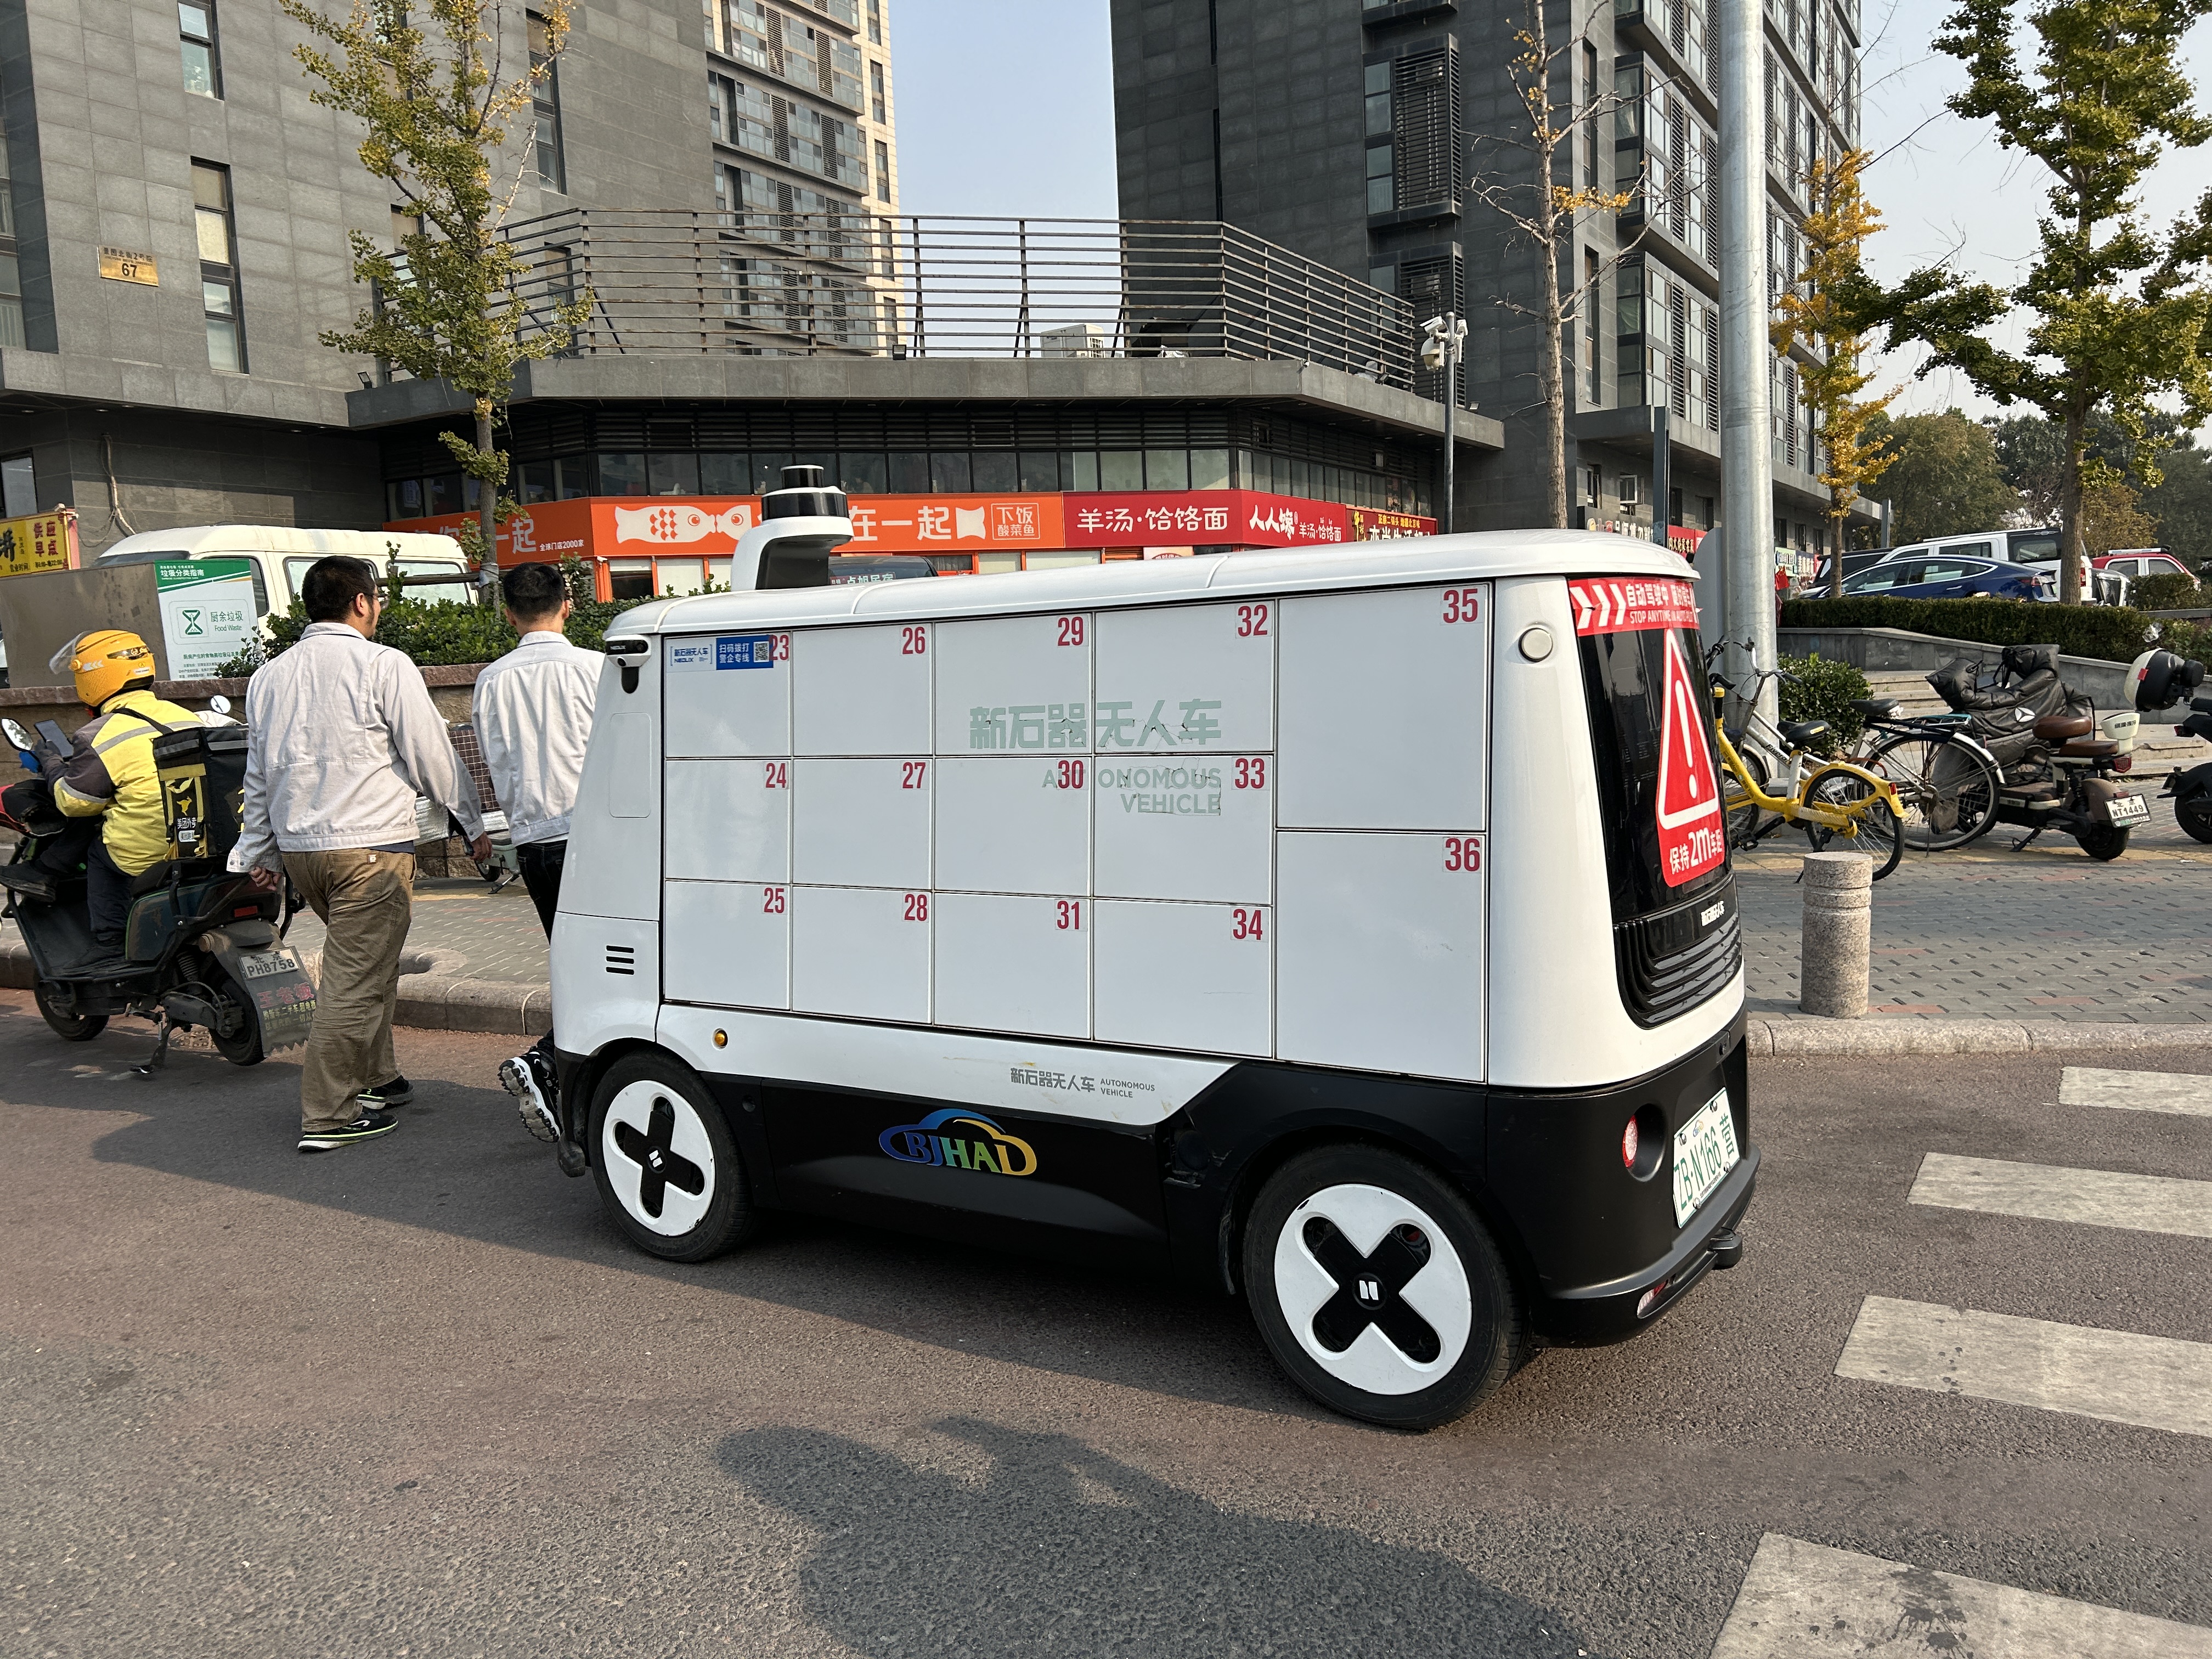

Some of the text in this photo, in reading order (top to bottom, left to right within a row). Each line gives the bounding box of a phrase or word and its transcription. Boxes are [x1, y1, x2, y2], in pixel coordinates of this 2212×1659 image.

[122, 263, 137, 277] 67
[996, 506, 1032, 524] 下饭
[997, 524, 1035, 537] 酸菜鱼
[35, 539, 59, 557] 早点
[539, 538, 584, 551] 全球门店2000家
[1444, 589, 1477, 623] 35
[1625, 583, 1669, 607] 自动驾驶中
[211, 611, 243, 622] 厨余垃圾
[1238, 605, 1267, 636] 32
[1630, 610, 1646, 624] STOP
[1648, 610, 1671, 623] ANYTIME
[902, 627, 925, 654] 26
[1058, 617, 1084, 646] 29
[719, 643, 750, 653] 扫码拨打
[769, 635, 789, 661] 23
[970, 699, 1221, 749] 新石器无人车
[766, 763, 786, 788] 24
[902, 762, 926, 788] 27
[1058, 760, 1084, 789] 30
[1235, 758, 1265, 788] 33
[1121, 793, 1221, 814] VEHICLE
[2112, 805, 2144, 817] NT1449
[177, 817, 197, 829] 美团外卖
[1446, 838, 1480, 871] 36
[1669, 827, 1723, 874] 保持2m车距
[764, 888, 785, 913] 25
[905, 894, 927, 921] 28
[1057, 901, 1079, 929] 31
[1233, 909, 1262, 940] 34
[247, 958, 295, 976] PH8758
[255, 952, 281, 964] 北京
[1011, 1068, 1095, 1092] 新石器无人车
[1100, 1078, 1155, 1091] AUTONOMOUS
[1101, 1087, 1133, 1098] VEHICLE
